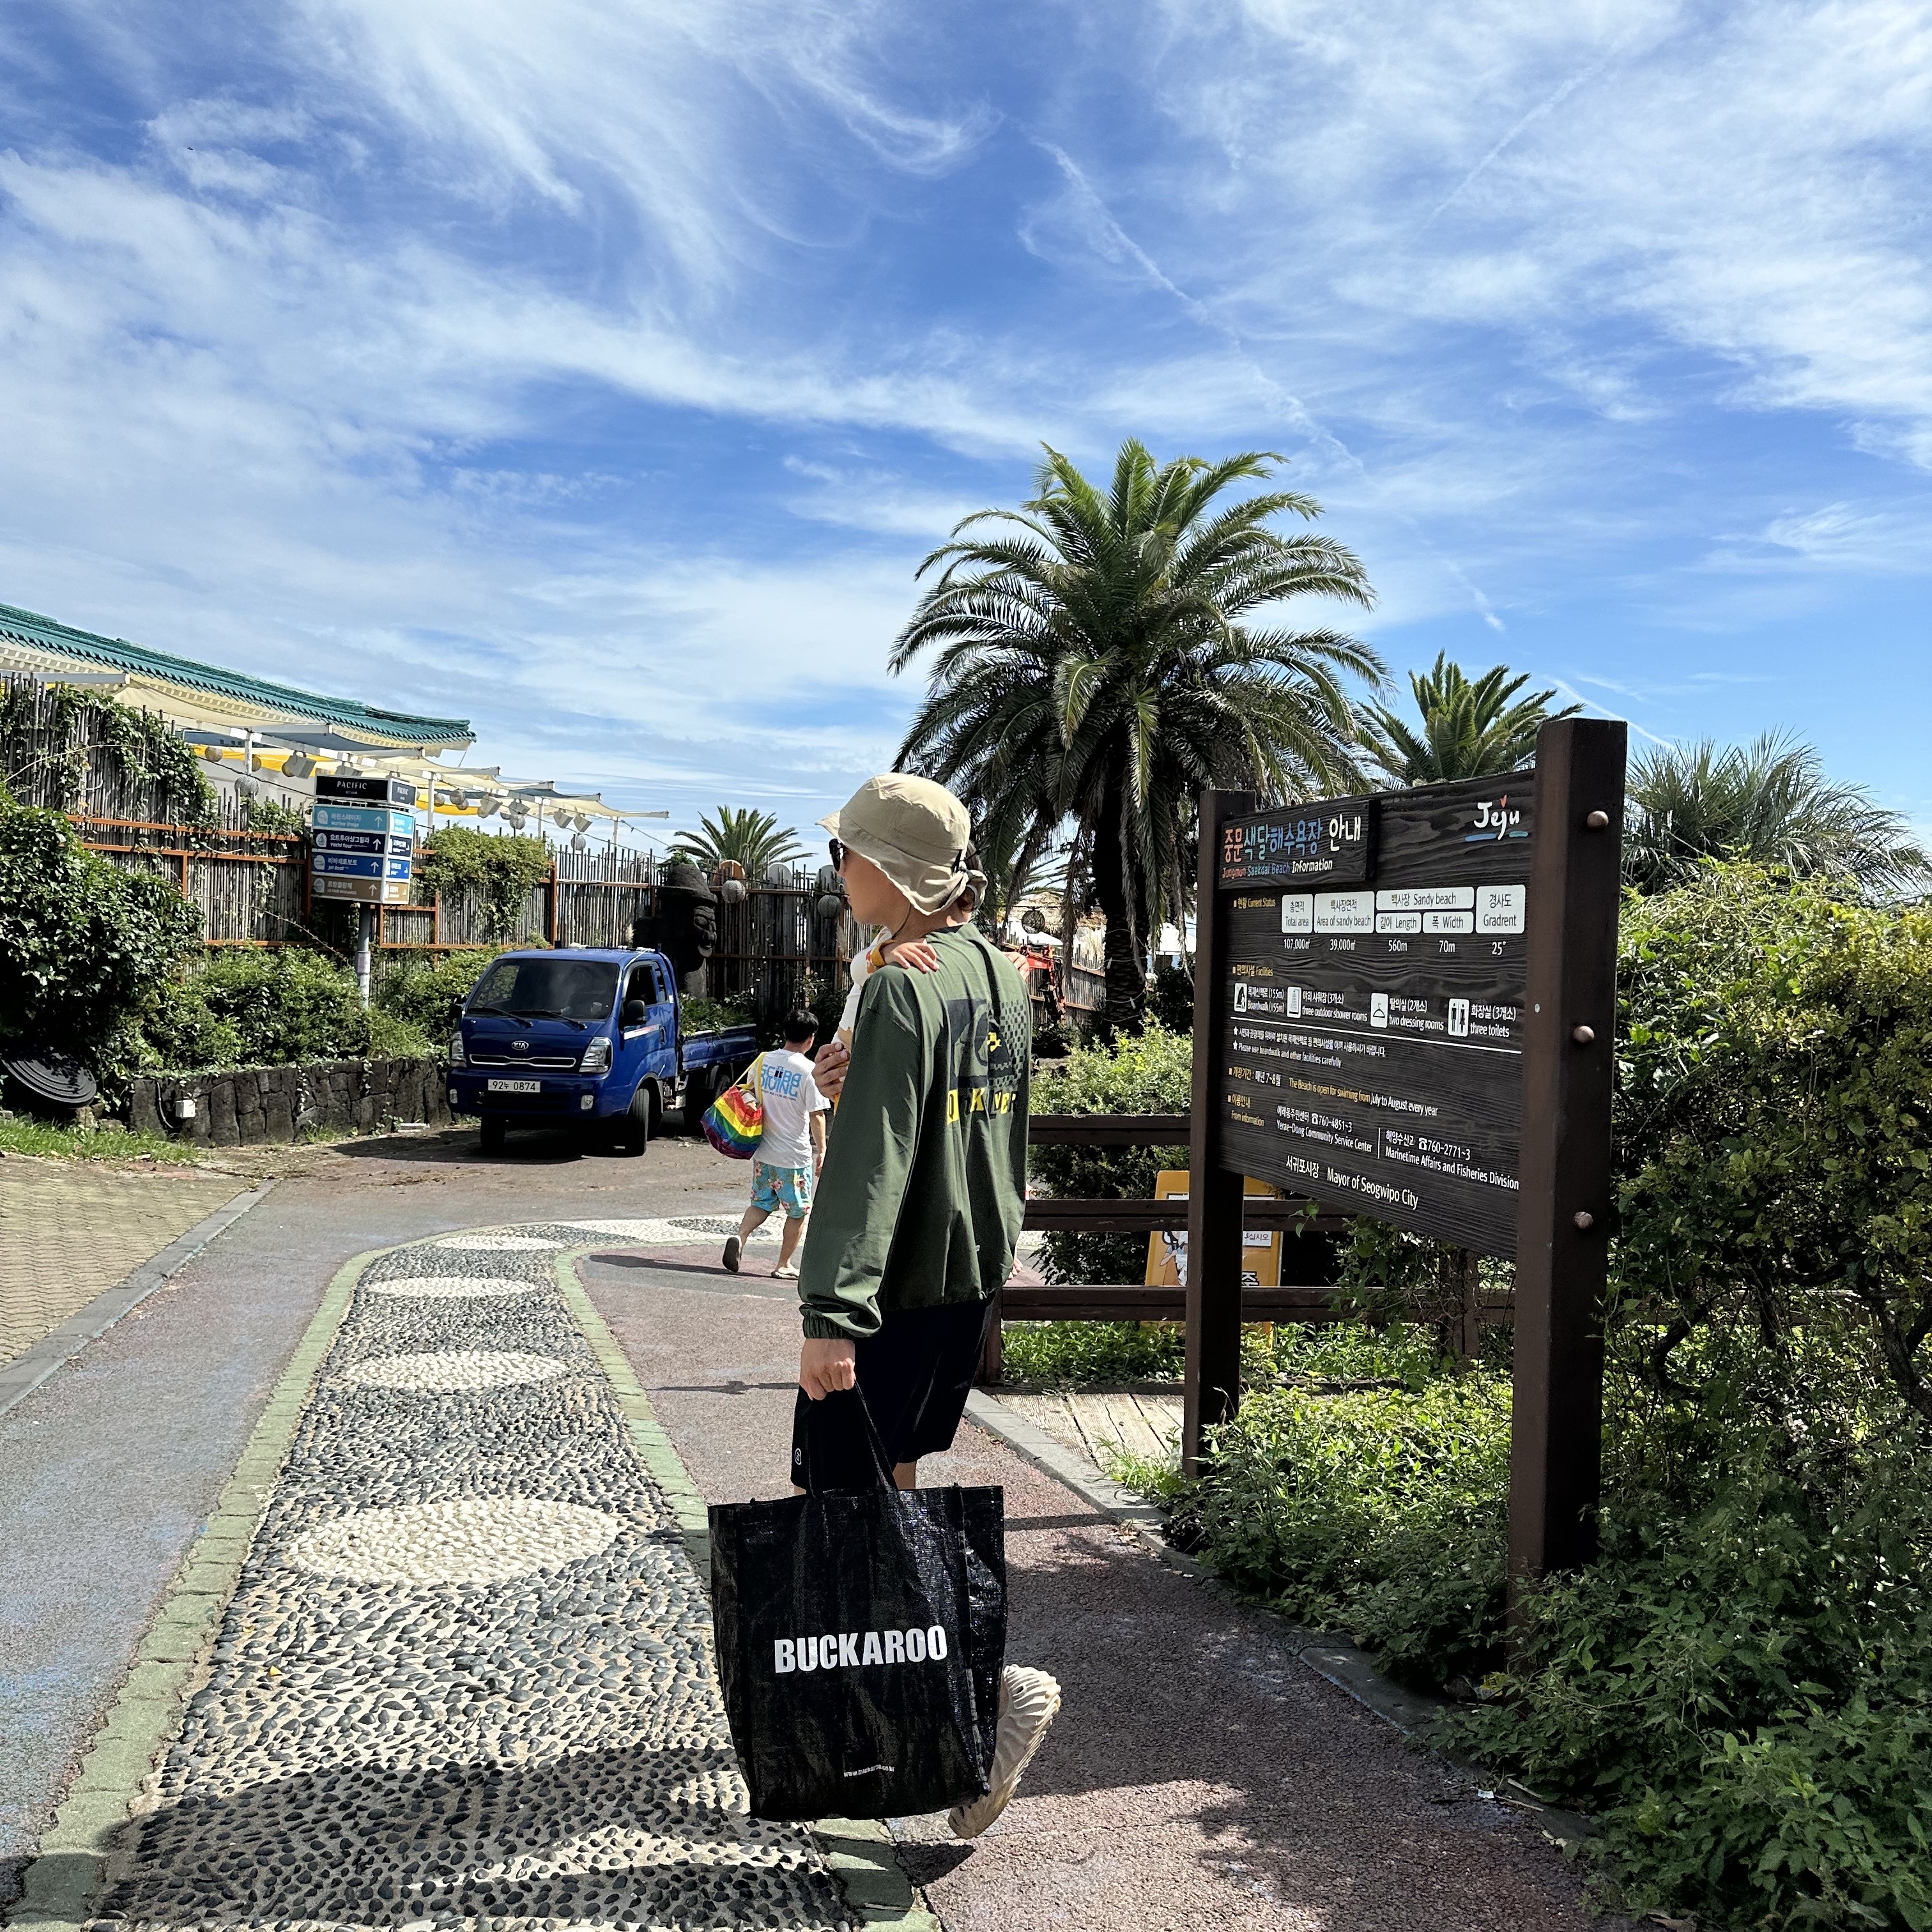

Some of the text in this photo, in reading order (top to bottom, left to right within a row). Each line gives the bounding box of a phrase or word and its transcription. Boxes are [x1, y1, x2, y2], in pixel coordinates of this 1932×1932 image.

[337, 781, 367, 790] PACIFIC
[1473, 795, 1521, 841] Jeju
[1224, 814, 1361, 862] 중문색달해수욕장 안내
[1222, 858, 1333, 880] Jungmun Saekdal Beach Information
[1248, 898, 1262, 908] Current
[1262, 898, 1276, 907] Status
[1290, 901, 1305, 913] 총면적
[1330, 899, 1357, 912] 백사장면적
[1392, 892, 1456, 907] 백사장 Sandy beach
[1489, 894, 1512, 908] 경사도
[1285, 916, 1309, 927] Total area
[1317, 915, 1371, 928] Area of sandy beach
[1380, 916, 1417, 931] 길이 Length
[1432, 916, 1464, 929] 폭 Width
[1388, 939, 1407, 952] 560m
[1439, 940, 1455, 952] 70m
[1237, 964, 1273, 977] 편의시설 Facilities
[1269, 988, 1284, 1000] (155m)
[1328, 992, 1344, 1005] (3개소)
[1269, 1001, 1285, 1014] (155m)
[1390, 998, 1428, 1013] 탈의실 (2개소)
[1471, 1004, 1516, 1022] 화장실 (3개소)
[1302, 1006, 1368, 1022] three outdoor shower rooms
[1389, 1015, 1445, 1031] two dressing rooms
[1470, 1022, 1510, 1038] three toilets
[1308, 1036, 1312, 1047] 등
[1313, 1038, 1333, 1050] 편의시설을
[1344, 1041, 1366, 1055] 사용하시기
[1238, 1043, 1252, 1053] Please
[1281, 1050, 1289, 1059] and
[1289, 1051, 1301, 1061] other
[1302, 1051, 1321, 1064] facilities
[1321, 1056, 1342, 1068] carefully
[493, 1081, 535, 1091] 92누 0874
[1233, 1066, 1252, 1080] 개장기간
[1255, 1070, 1265, 1084] 매년
[1289, 1077, 1297, 1088] The
[1298, 1080, 1312, 1091] Beach
[1312, 1081, 1317, 1092] is
[1317, 1086, 1329, 1096] open
[1358, 1090, 1370, 1103] from
[1370, 1092, 1381, 1107] July
[1381, 1095, 1387, 1107] to
[1388, 1096, 1408, 1111] August
[1408, 1102, 1424, 1116] every
[1425, 1105, 1438, 1117] year
[1232, 1094, 1250, 1109] 이용안내
[1241, 1112, 1265, 1127] information
[1305, 1126, 1333, 1145] Community
[1334, 1133, 1354, 1148] Service
[1354, 1138, 1373, 1153] Center
[1385, 1146, 1519, 1190] Marinetime Affairs and Fisheries Division
[1285, 1155, 1419, 1210] 서귀포시장 Mayor of Seogwipo City
[774, 1625, 949, 1674] BUCKAROO
